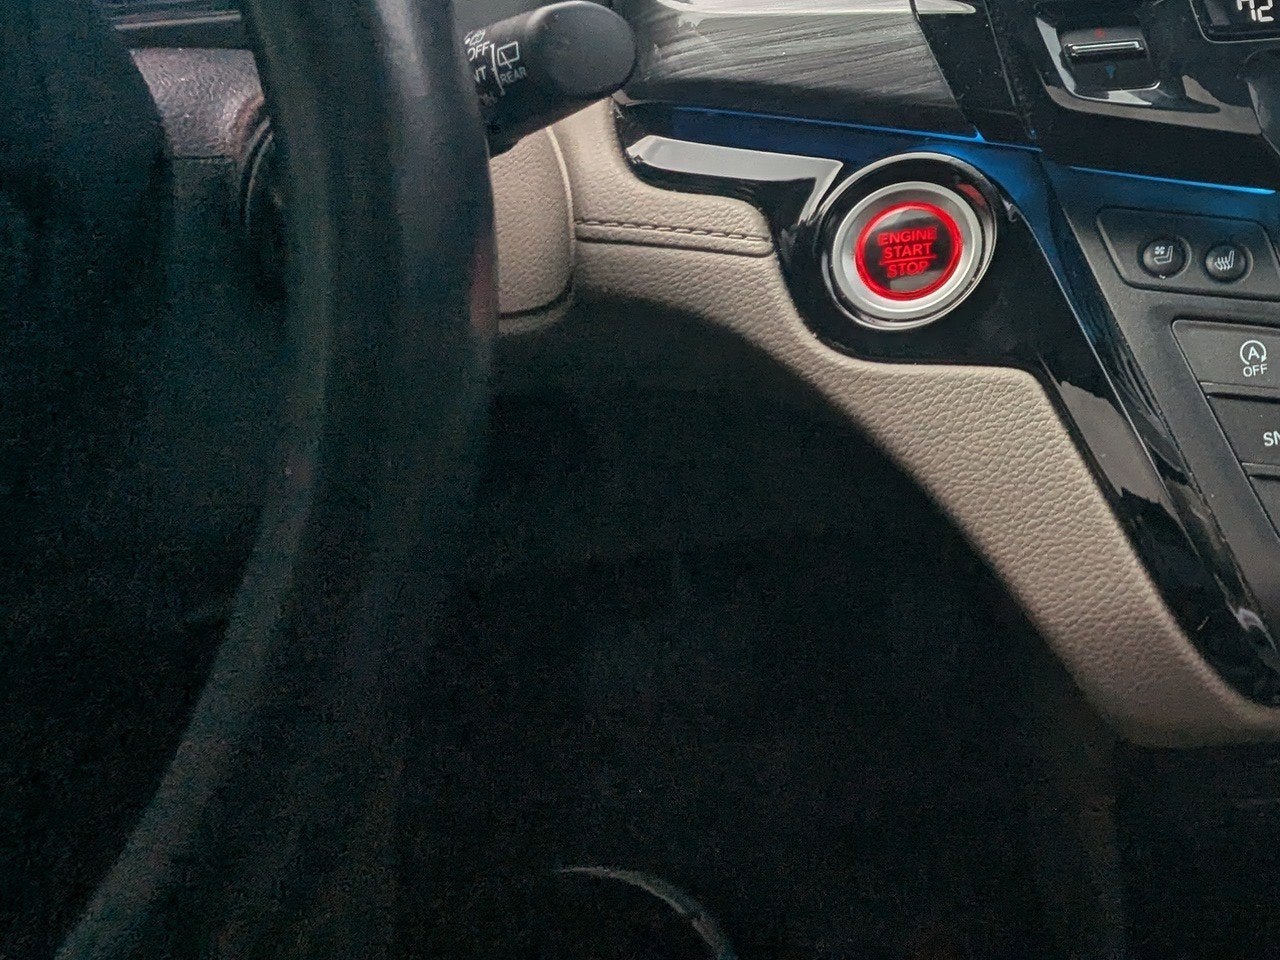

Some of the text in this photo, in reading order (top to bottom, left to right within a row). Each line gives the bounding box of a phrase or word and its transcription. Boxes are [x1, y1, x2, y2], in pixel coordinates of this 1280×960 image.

[877, 226, 938, 247] ENGINE
[882, 242, 933, 259] START
[886, 260, 930, 278] STOP
[1242, 363, 1268, 378] OFF
